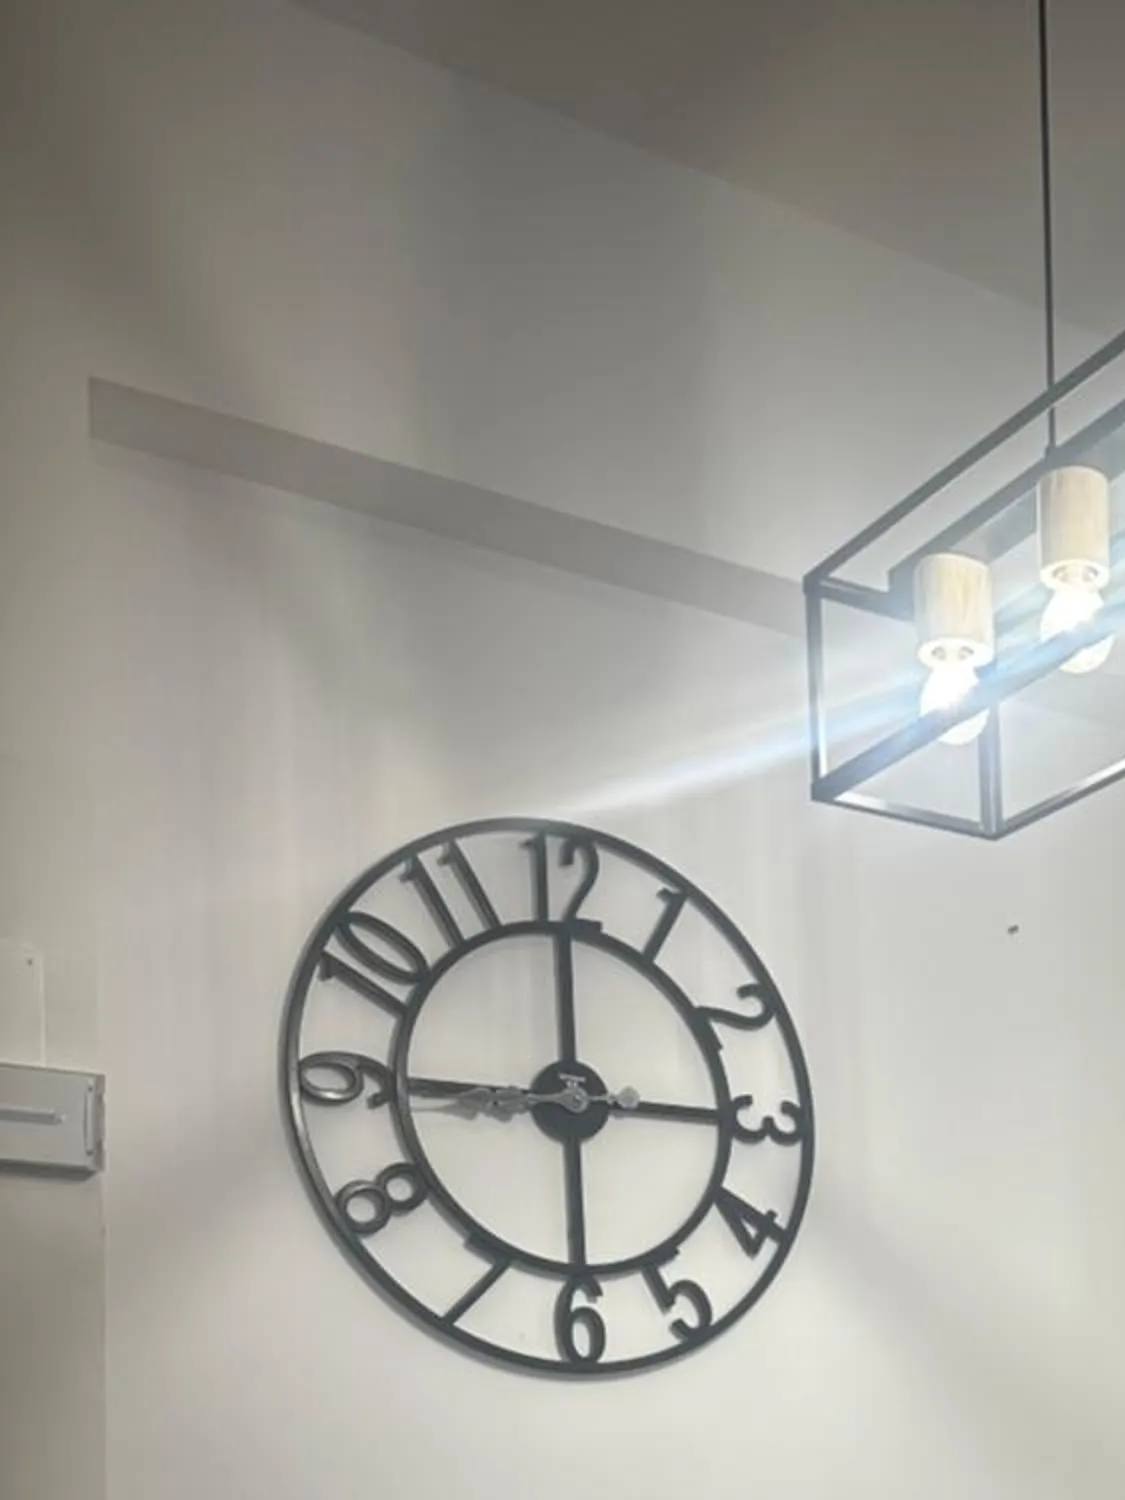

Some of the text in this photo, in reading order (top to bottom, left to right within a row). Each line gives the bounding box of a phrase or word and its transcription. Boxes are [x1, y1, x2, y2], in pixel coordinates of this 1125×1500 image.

[399, 839, 503, 946] 11
[519, 834, 603, 937] 12
[643, 887, 692, 964] 1
[318, 912, 432, 1019] 10
[694, 982, 777, 1053] 2
[298, 1051, 397, 1108] 9
[731, 1095, 802, 1145] 3
[334, 1162, 432, 1234] 8
[714, 1187, 790, 1259] 4
[554, 1272, 606, 1365] 6
[641, 1244, 713, 1342] 5
